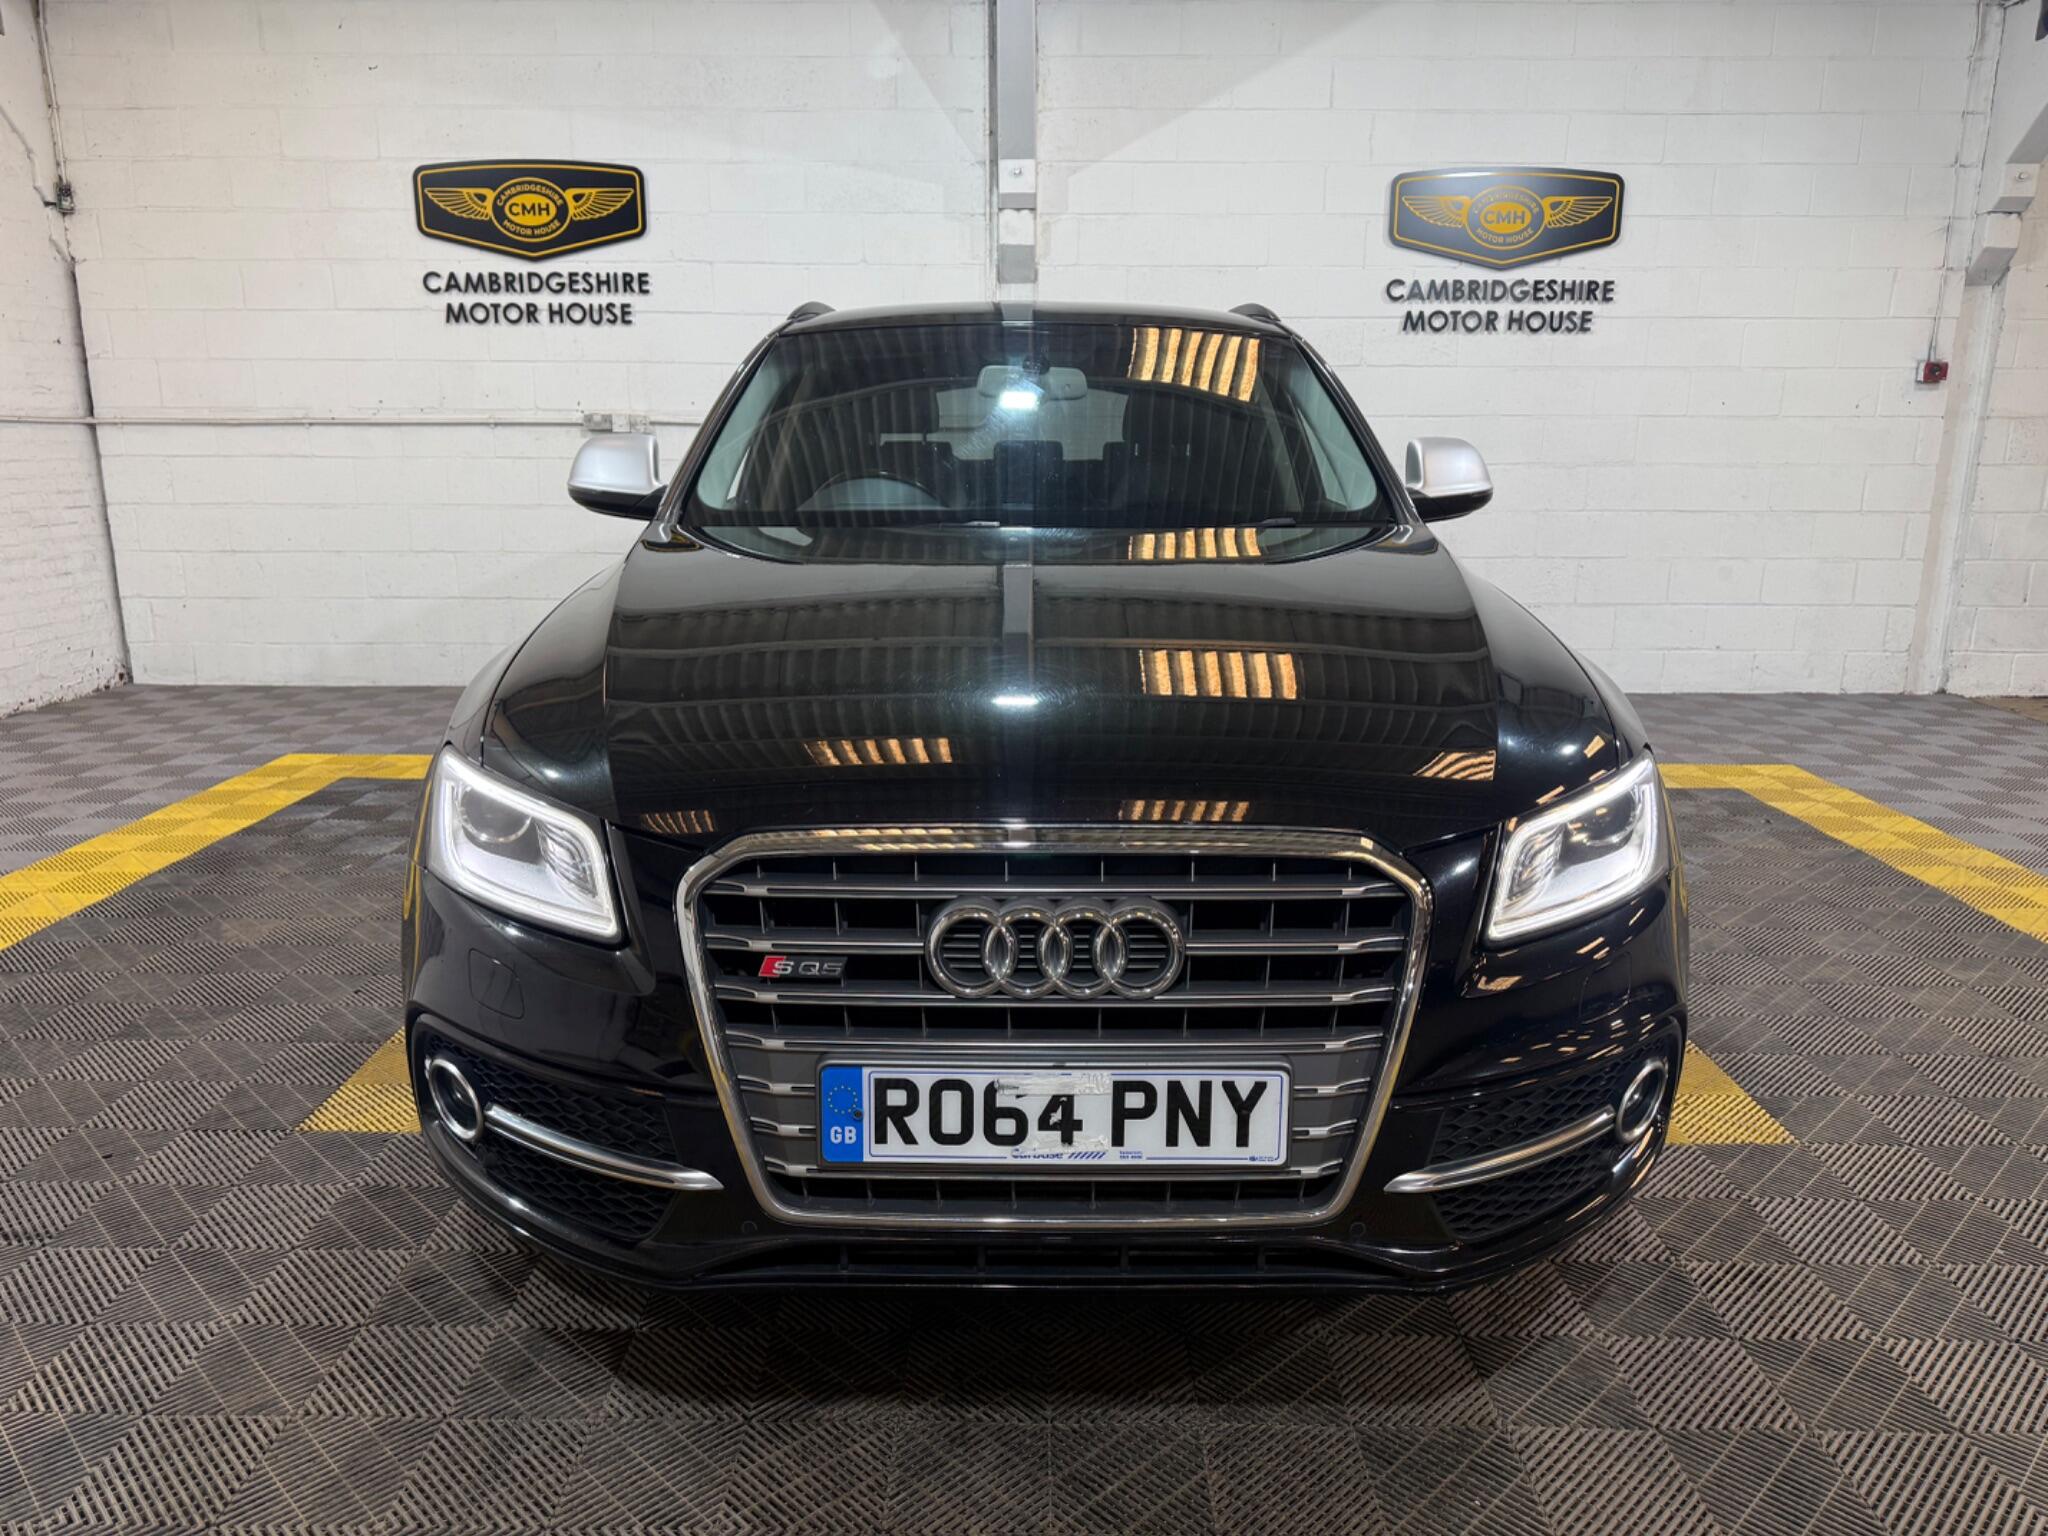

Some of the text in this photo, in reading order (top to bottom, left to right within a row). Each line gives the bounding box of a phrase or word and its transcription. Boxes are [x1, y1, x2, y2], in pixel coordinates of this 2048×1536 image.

[497, 184, 564, 206] CAMBRIDGESHIRE
[509, 202, 550, 216] CMH
[1484, 209, 1526, 225] CMH
[503, 219, 561, 235] MOTOR HOUSE
[423, 271, 650, 295] CAMBRIDGESHIRE
[1386, 278, 1615, 303] CAMBRIDGESHIRE
[446, 302, 633, 325] MOTOR HOUSE
[1402, 310, 1593, 334] MOTOR HOUSE
[1111, 1080, 1267, 1148] PNY
[829, 1126, 857, 1145] GB
